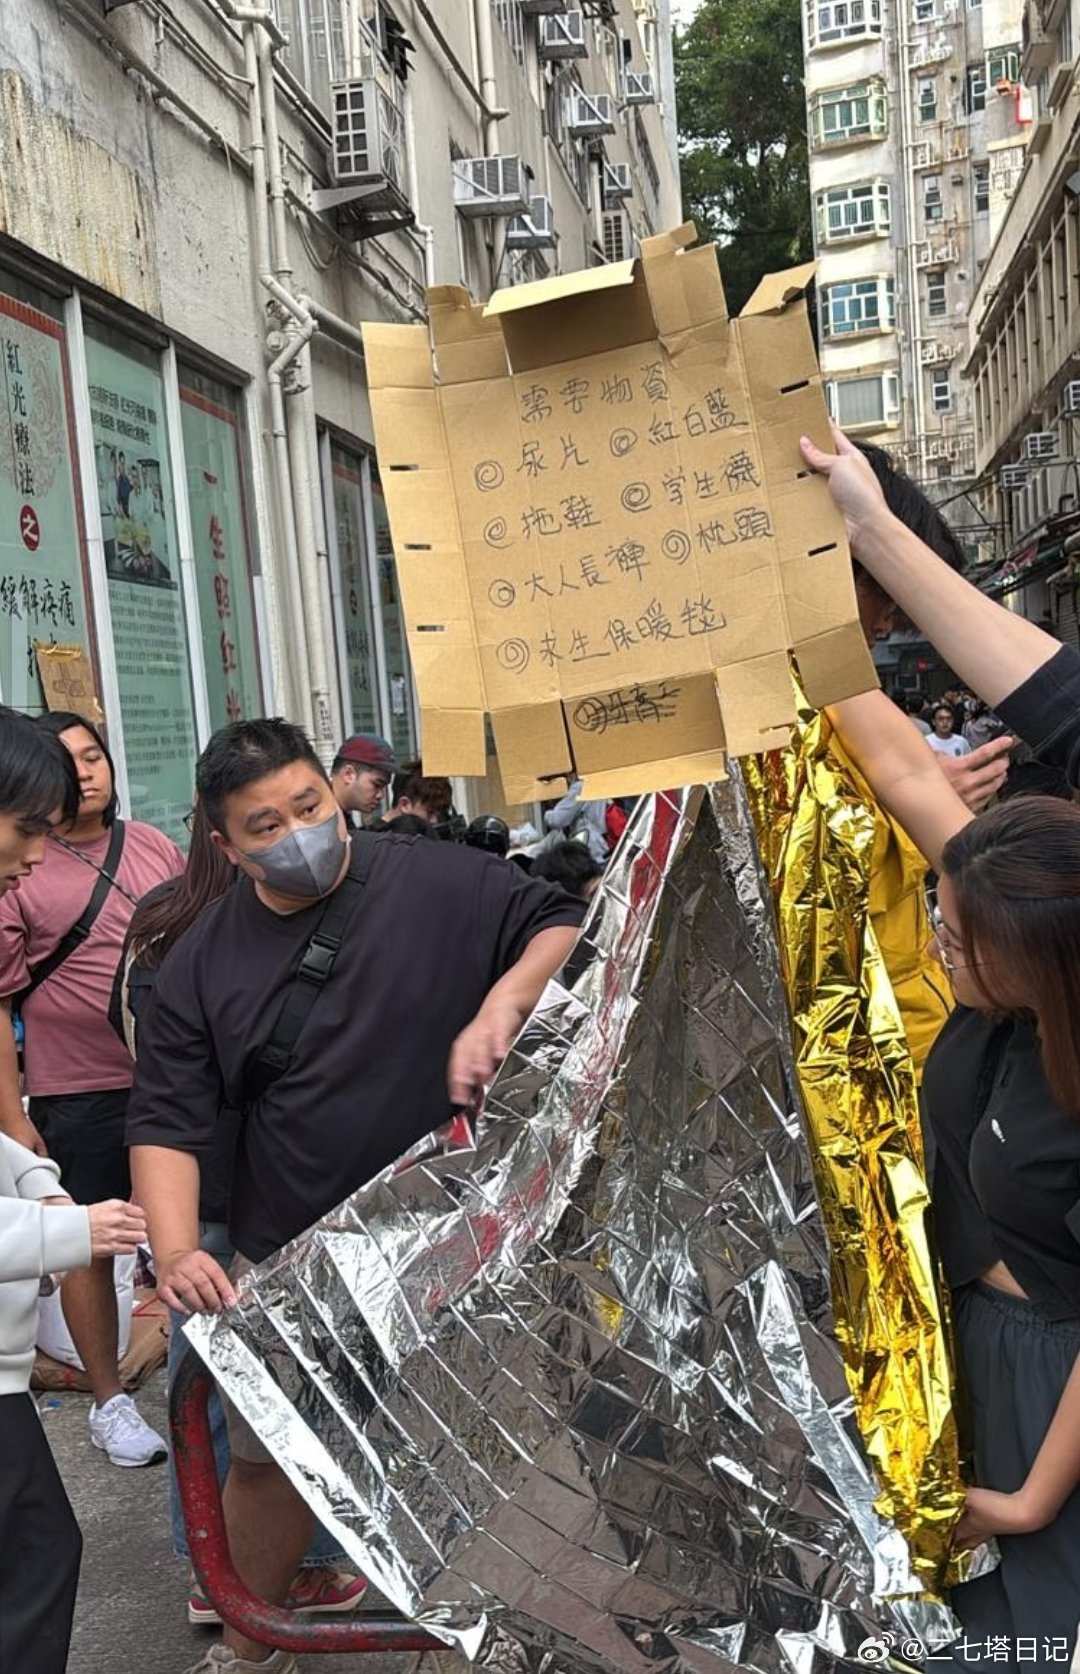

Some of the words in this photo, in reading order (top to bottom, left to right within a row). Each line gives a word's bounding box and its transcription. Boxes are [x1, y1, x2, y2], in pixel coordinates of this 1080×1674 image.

[6, 339, 35, 496] 紅光療法
[521, 361, 669, 424] 需要物資
[516, 434, 589, 478] 尿片
[521, 495, 602, 540] 拖鞋
[695, 506, 774, 553] 枕頭
[0, 575, 75, 627] 緩解疼痛
[540, 594, 727, 668] 求生保暖毯
